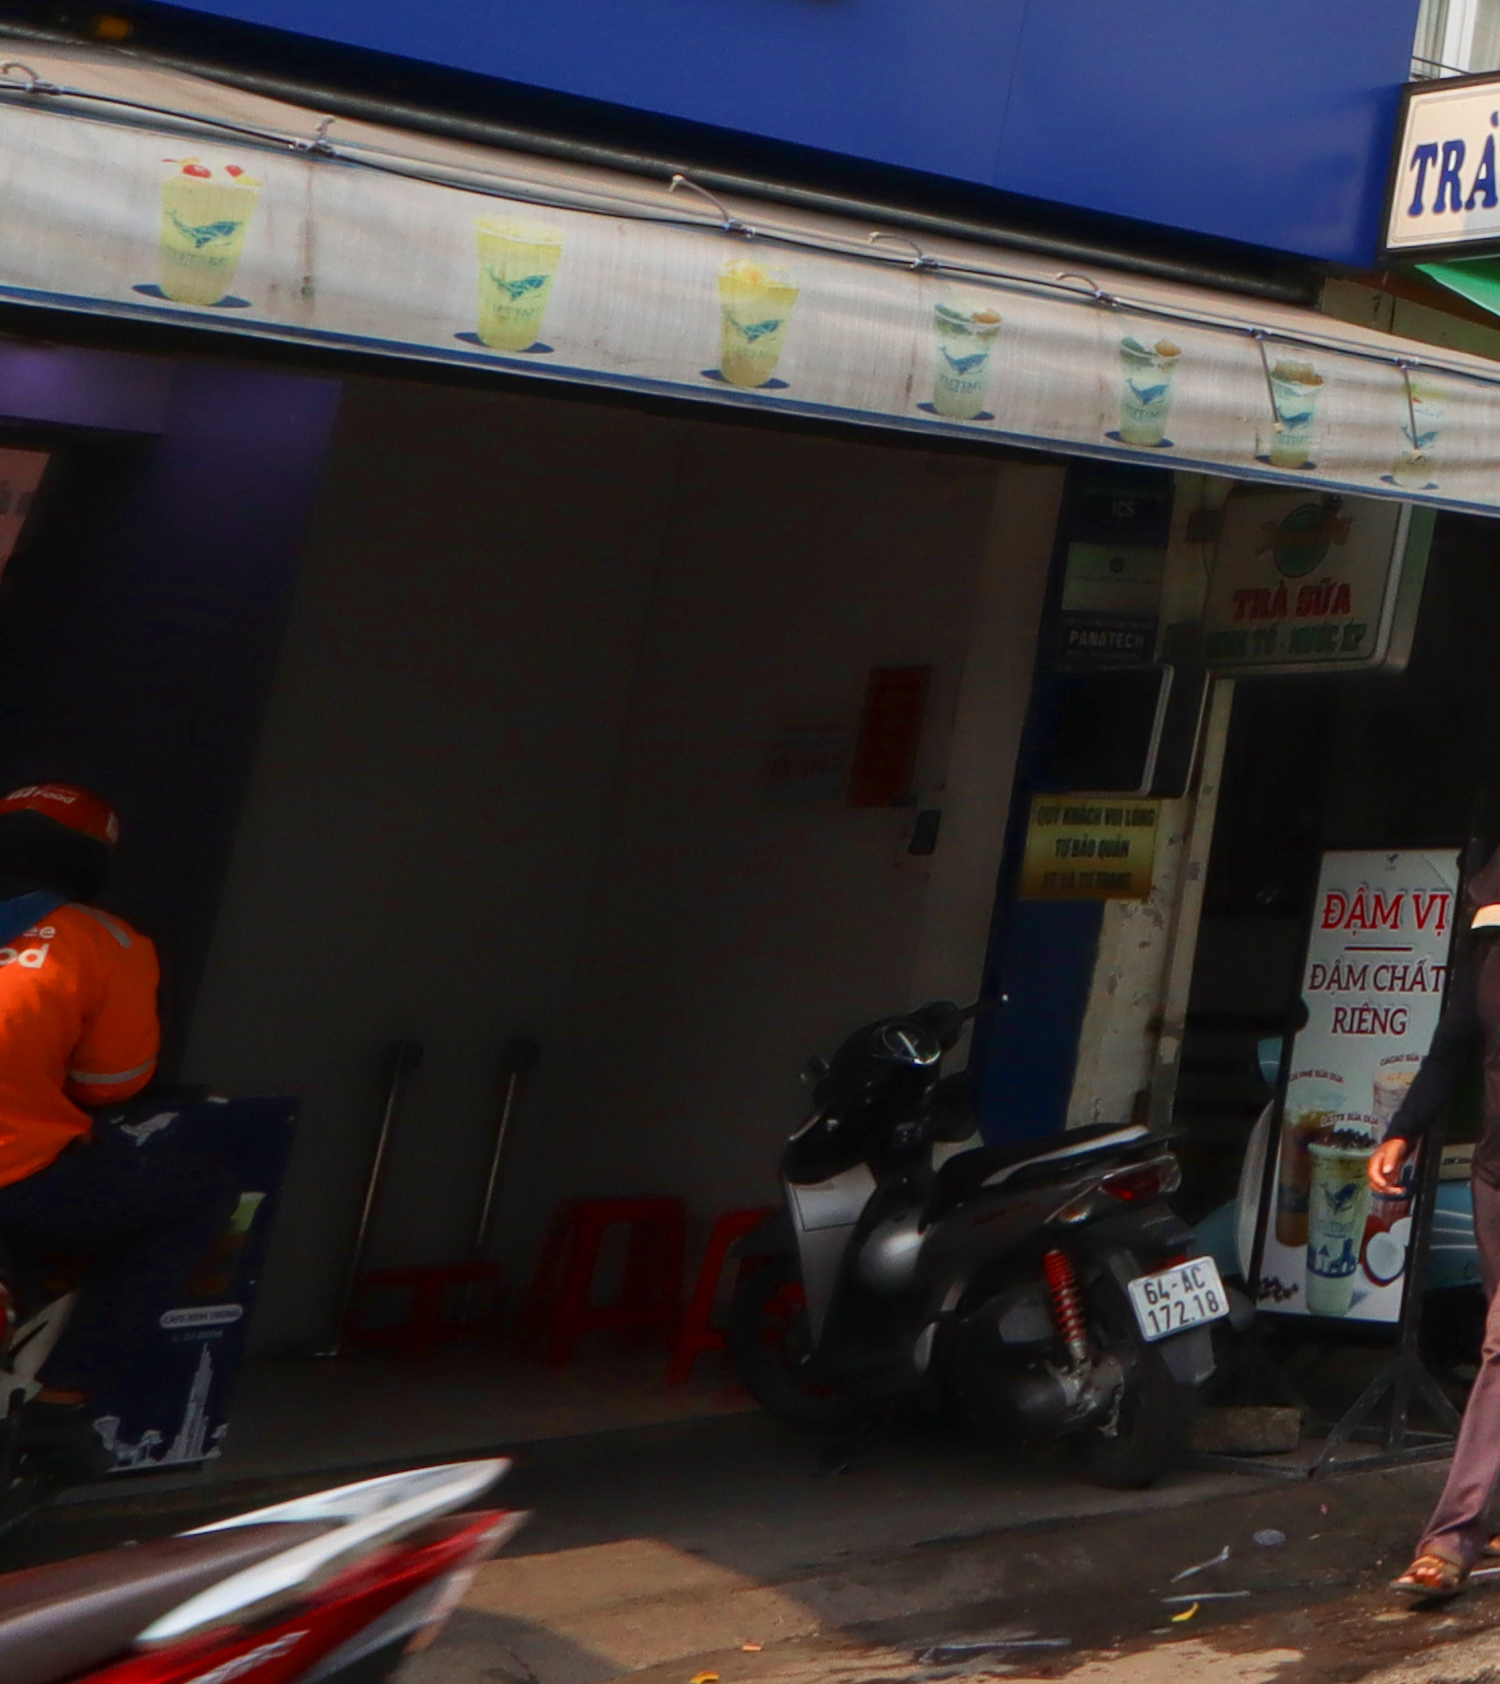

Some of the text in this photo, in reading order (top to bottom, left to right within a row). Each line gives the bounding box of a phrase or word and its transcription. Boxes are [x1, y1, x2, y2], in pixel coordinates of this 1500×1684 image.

[1321, 886, 1450, 937] ĐẬM VỊ
[1309, 957, 1448, 996] ĐẬM CHẤT
[1331, 1001, 1408, 1036] RIÊNG
[1143, 1266, 1206, 1306] 64-AC
[1147, 1289, 1220, 1334] 172.18
